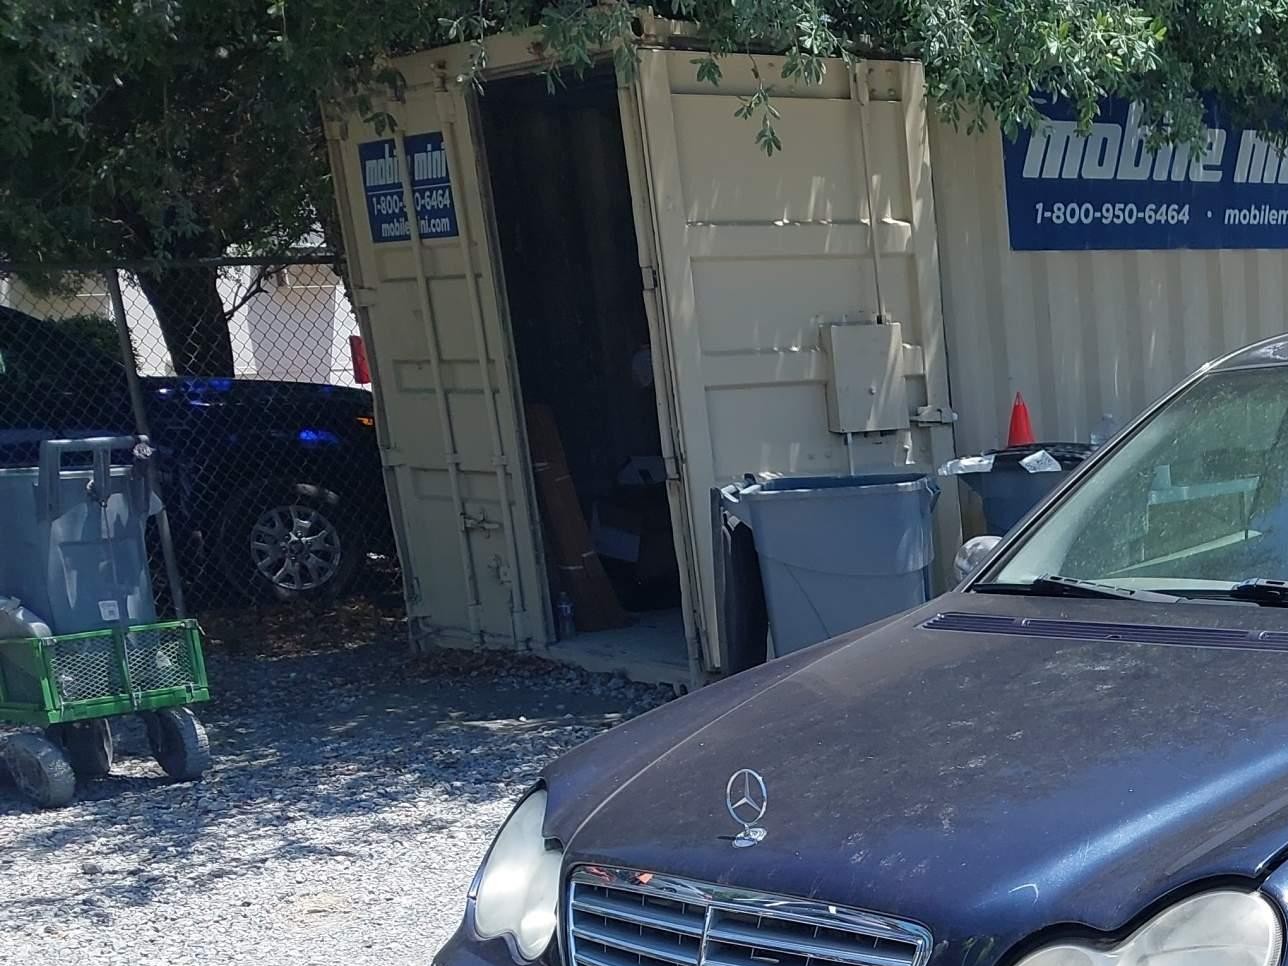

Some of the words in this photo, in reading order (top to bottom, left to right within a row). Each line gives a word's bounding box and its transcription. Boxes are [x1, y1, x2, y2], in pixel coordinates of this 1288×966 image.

[365, 143, 411, 187] mobi
[413, 142, 447, 181] mini
[372, 188, 451, 215] 1-800-0-6464
[381, 215, 450, 237] mobileni.com
[1035, 203, 1190, 225] 1-800-950-6464
